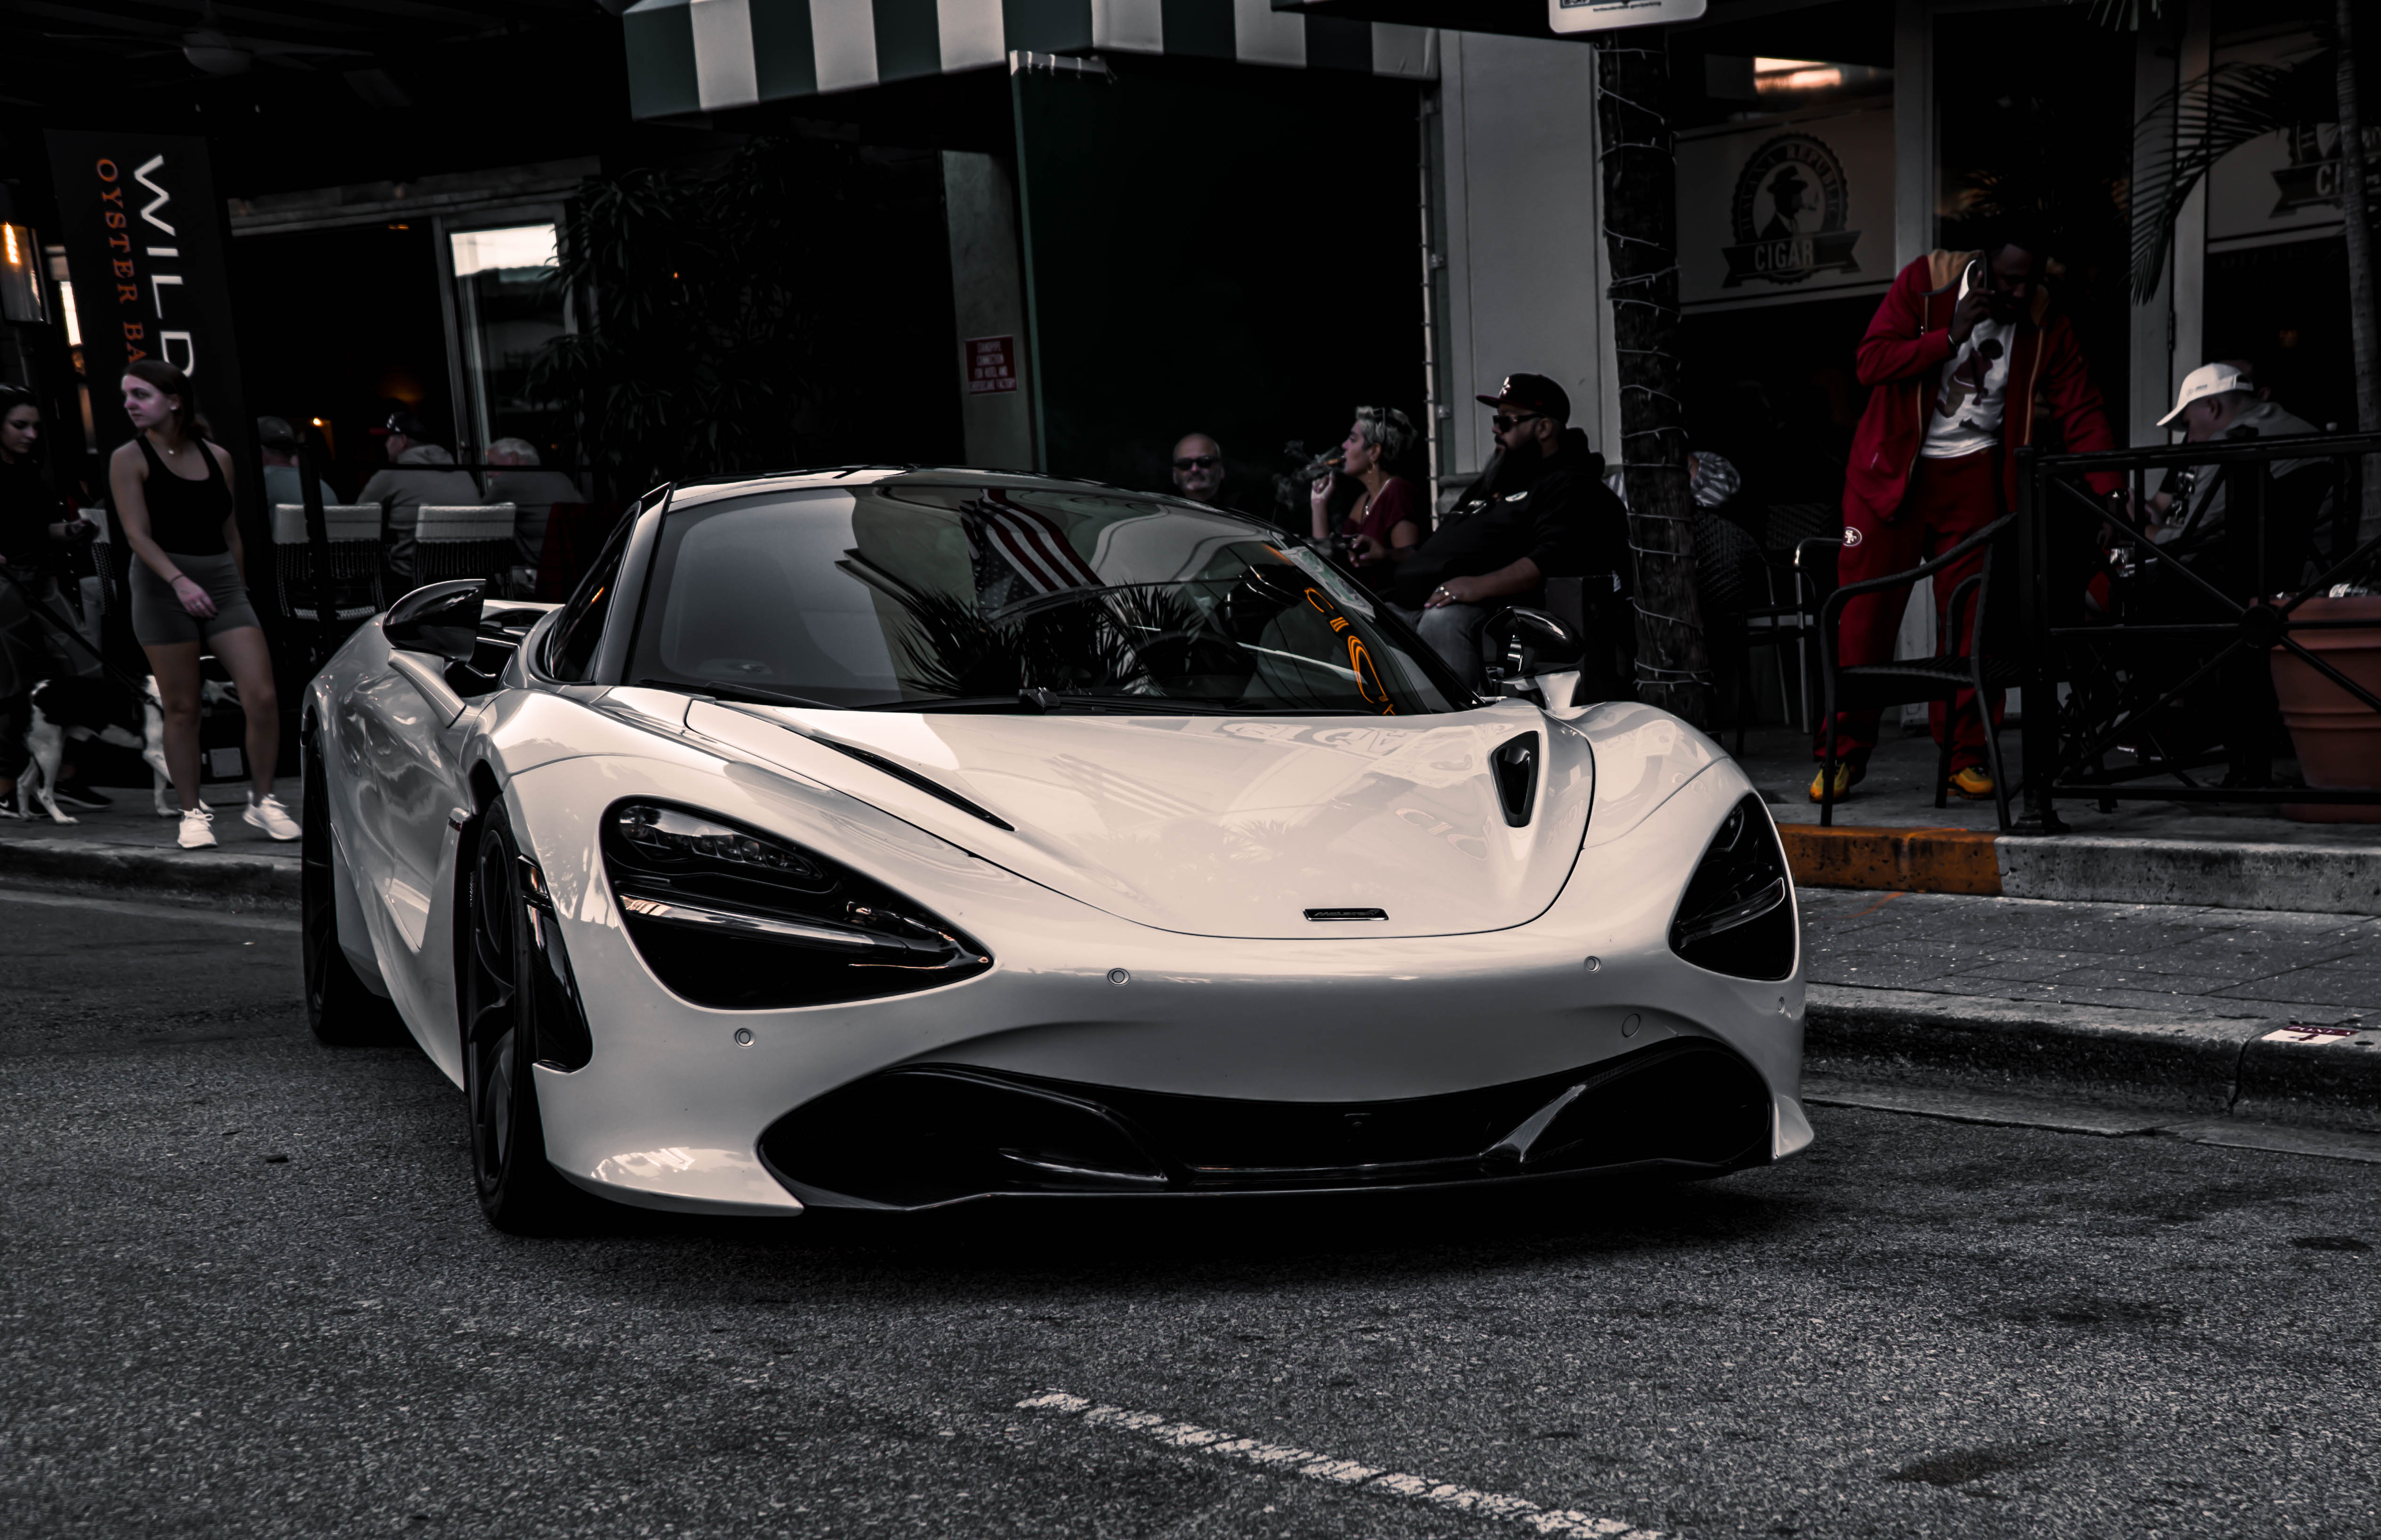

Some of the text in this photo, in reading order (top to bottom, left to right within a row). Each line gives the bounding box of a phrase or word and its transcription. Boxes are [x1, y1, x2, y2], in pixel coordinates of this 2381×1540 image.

[96, 158, 138, 305] OYSTER
[1786, 144, 1841, 217] REPUBLIC
[134, 154, 195, 378] WILD
[1754, 239, 1815, 272] CIGAR
